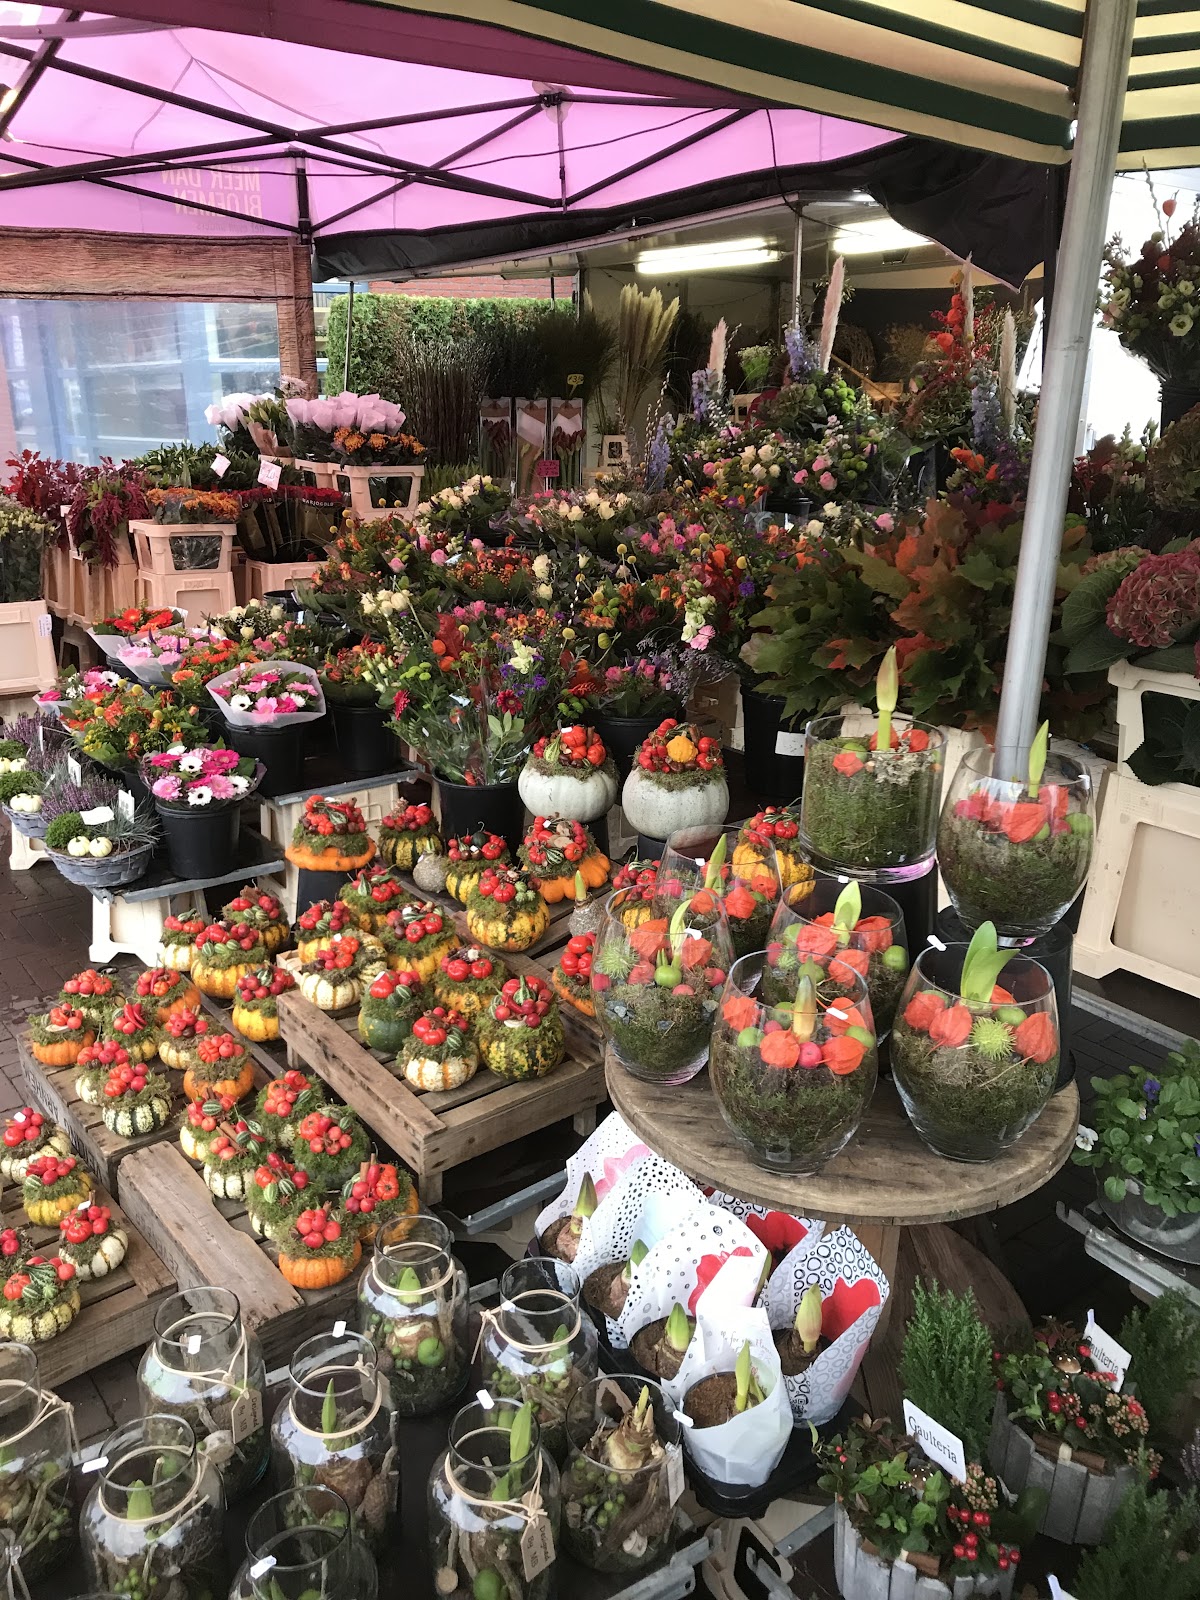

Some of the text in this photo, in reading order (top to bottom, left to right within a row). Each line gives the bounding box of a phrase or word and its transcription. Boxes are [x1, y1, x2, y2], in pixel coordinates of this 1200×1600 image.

[250, 1396, 260, 1428] Designed
[908, 1415, 958, 1465] Gaulteria
[527, 1535, 535, 1550] By
[539, 1524, 551, 1562] Designed
